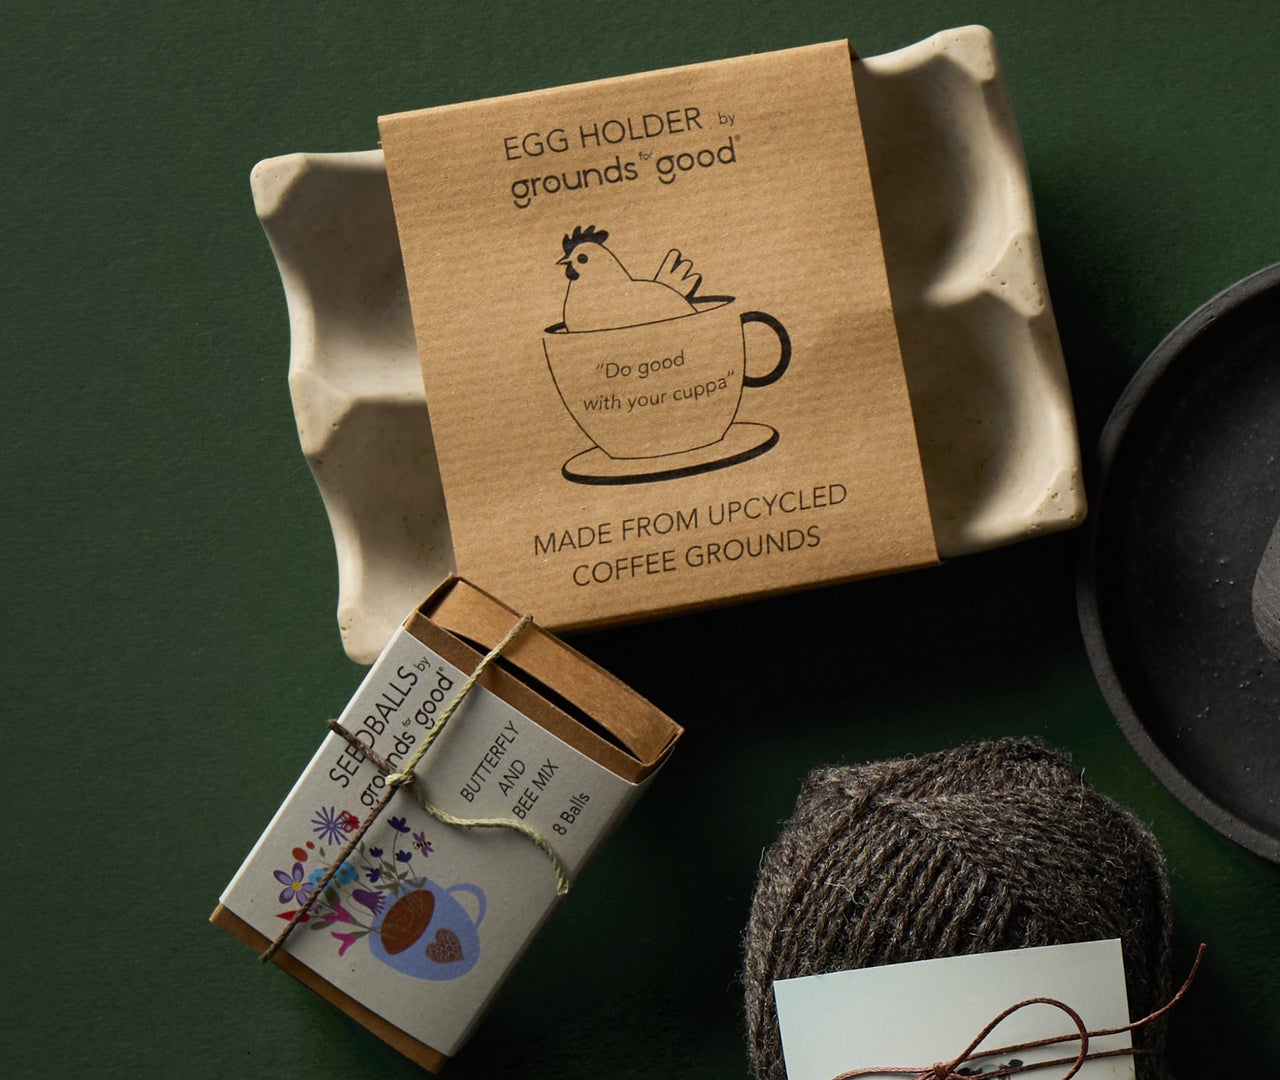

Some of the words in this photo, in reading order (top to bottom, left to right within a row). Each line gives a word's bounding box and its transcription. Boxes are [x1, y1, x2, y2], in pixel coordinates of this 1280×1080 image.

[503, 128, 569, 160] EGG
[579, 107, 703, 148] HOLDER
[718, 112, 735, 127] by
[510, 155, 639, 208] grounds
[638, 349, 685, 379] good
[583, 395, 622, 412] with
[627, 392, 667, 413] your
[533, 522, 612, 556] MADE
[621, 508, 699, 541] FROM
[708, 483, 848, 527] UPCYCLED
[572, 550, 677, 587] COFFEE
[685, 525, 821, 568] GROUNDS
[414, 657, 431, 672] by
[460, 720, 519, 803] BUTTERFLY
[498, 760, 526, 797] AND
[512, 788, 539, 820] BEE
[532, 759, 559, 791] MIX
[552, 823, 567, 836] 8
[560, 792, 590, 824] Balls
